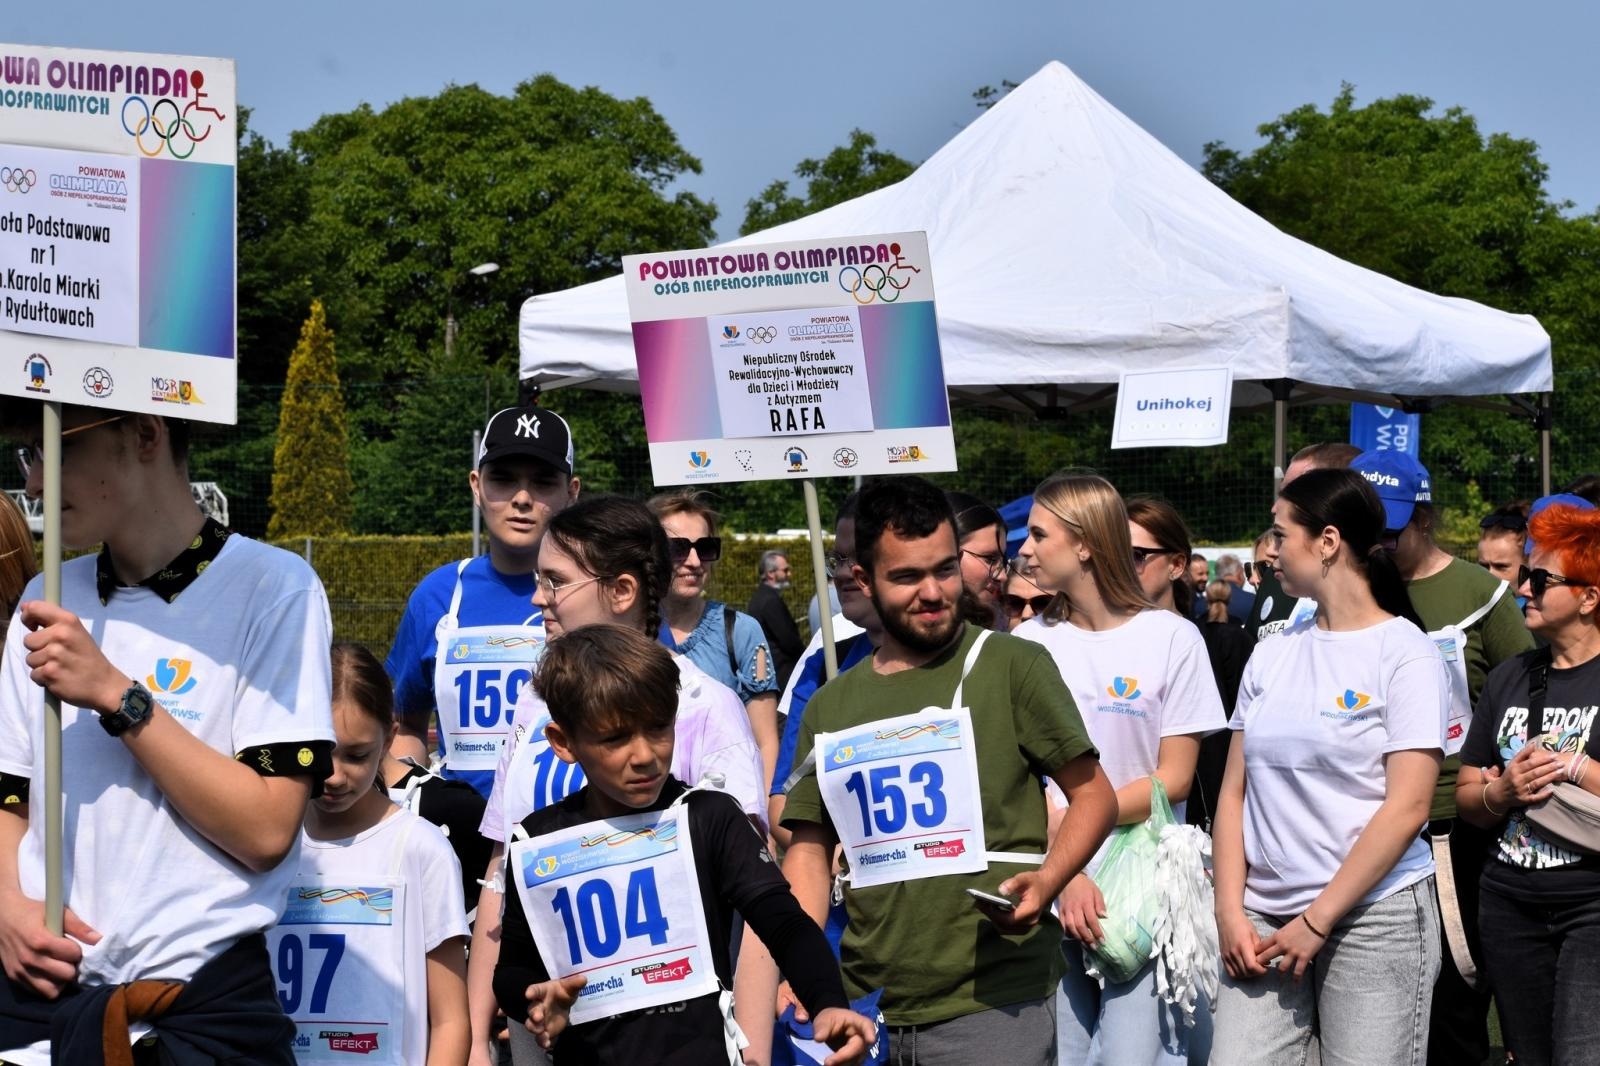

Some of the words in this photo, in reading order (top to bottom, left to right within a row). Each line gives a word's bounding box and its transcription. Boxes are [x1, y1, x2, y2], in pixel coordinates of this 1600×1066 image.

[0, 56, 40, 86] WA
[47, 60, 188, 98] OLIMPIADA
[78, 165, 126, 179] POWIATOWA
[50, 174, 128, 196] OLIMPIADA
[27, 213, 110, 243] Podstawowa
[31, 247, 46, 265] nr
[49, 244, 55, 266] 1
[639, 252, 770, 281] POWIATOWA
[774, 243, 890, 271] OLIMPIADA
[0, 268, 51, 294] .Karola
[56, 274, 100, 300] Miarki
[653, 280, 690, 296] OSÓB
[692, 270, 829, 293] NIEPEŁNOSPRAWNYCH
[6, 296, 94, 328] Rydułtowach
[810, 315, 851, 324] POWIATOWA
[787, 322, 854, 337] OLIMPIADA
[743, 353, 798, 367] Niepubliczny
[800, 349, 836, 362] Ośrodek
[729, 364, 854, 381] Rewalidacyjno-Wychowawczy
[747, 382, 761, 394] dla
[763, 380, 789, 393] Dzieci
[791, 380, 794, 391] i
[796, 378, 839, 391] Młodzieży
[767, 396, 772, 406] z
[774, 392, 822, 407] Autyzmem
[1136, 396, 1212, 412] Unihokej
[769, 406, 826, 432] RAFA
[1497, 706, 1599, 743] FREDOM
[845, 761, 947, 837] 153
[863, 848, 907, 865] Summer-cha
[926, 845, 959, 856] EFEKT
[551, 866, 669, 966] 104
[278, 933, 346, 1014] 97
[634, 963, 662, 973] STUDIO
[646, 966, 685, 982] EFEKT
[332, 1039, 372, 1049] EFEKT
